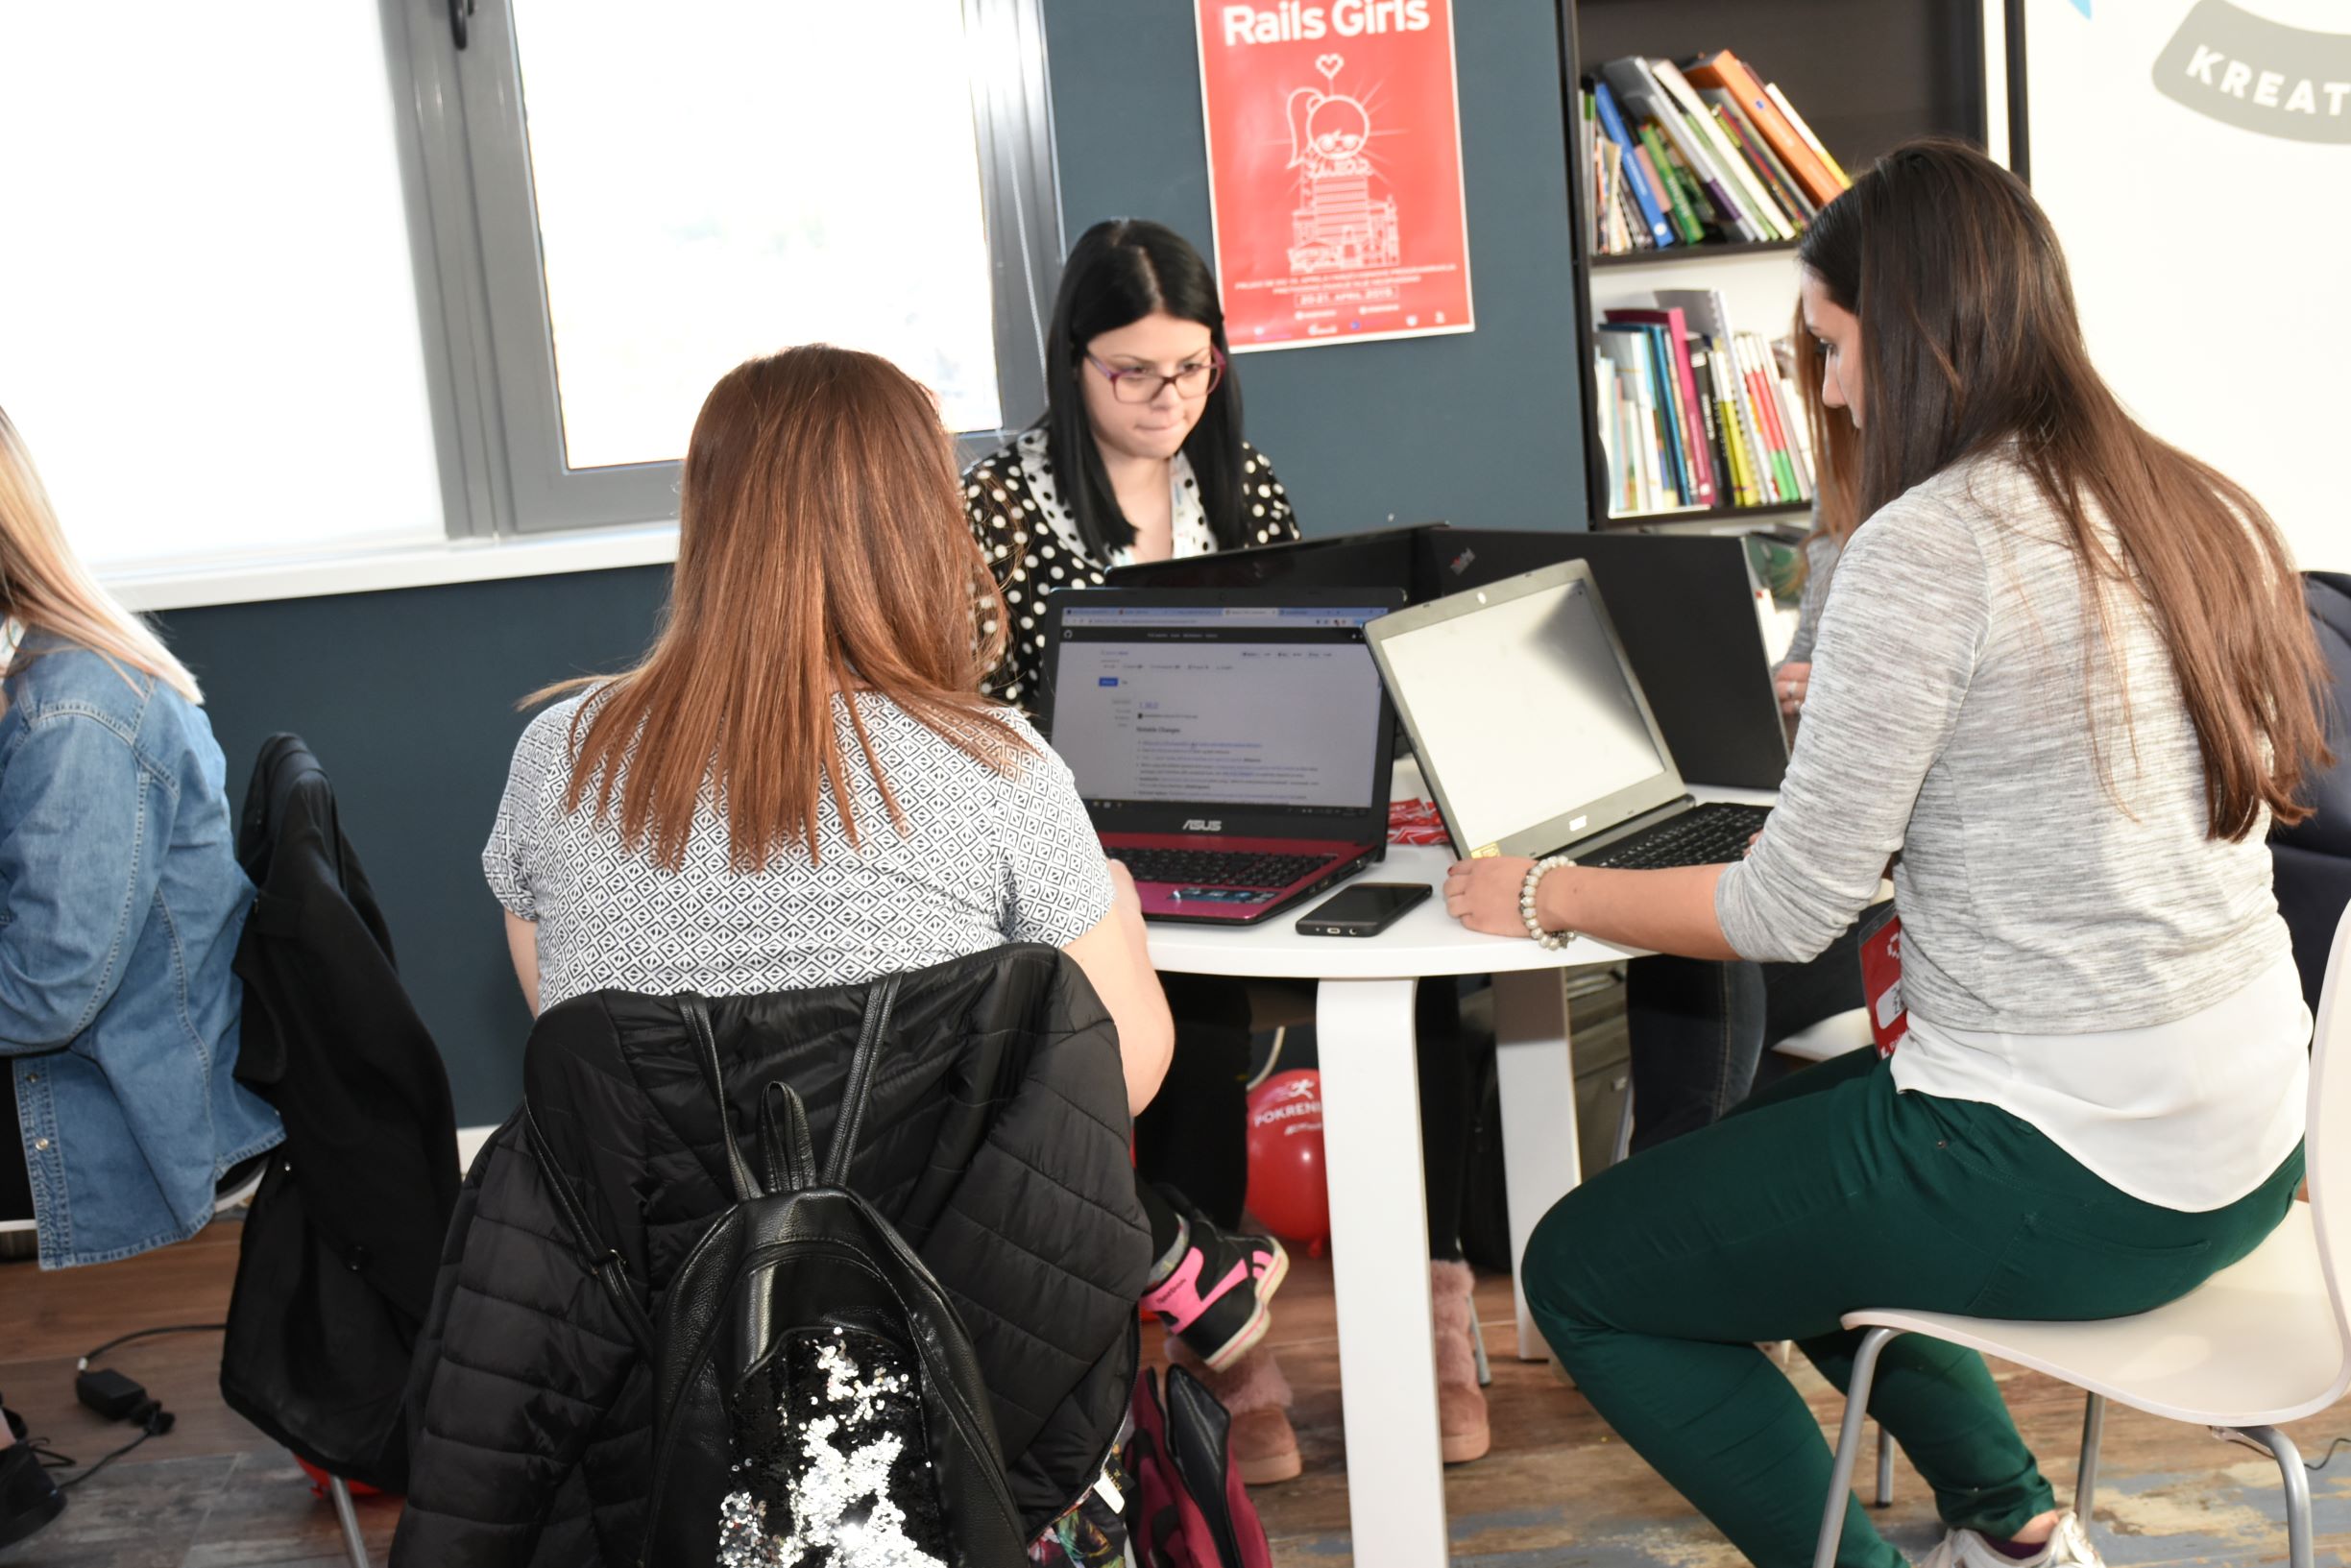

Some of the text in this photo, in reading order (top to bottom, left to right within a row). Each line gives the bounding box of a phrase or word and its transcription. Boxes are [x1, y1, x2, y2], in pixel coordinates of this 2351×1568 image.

[1223, 0, 1430, 46] Rails Girls
[2185, 44, 2351, 116] KREAT
[1182, 819, 1222, 832] ASUS
